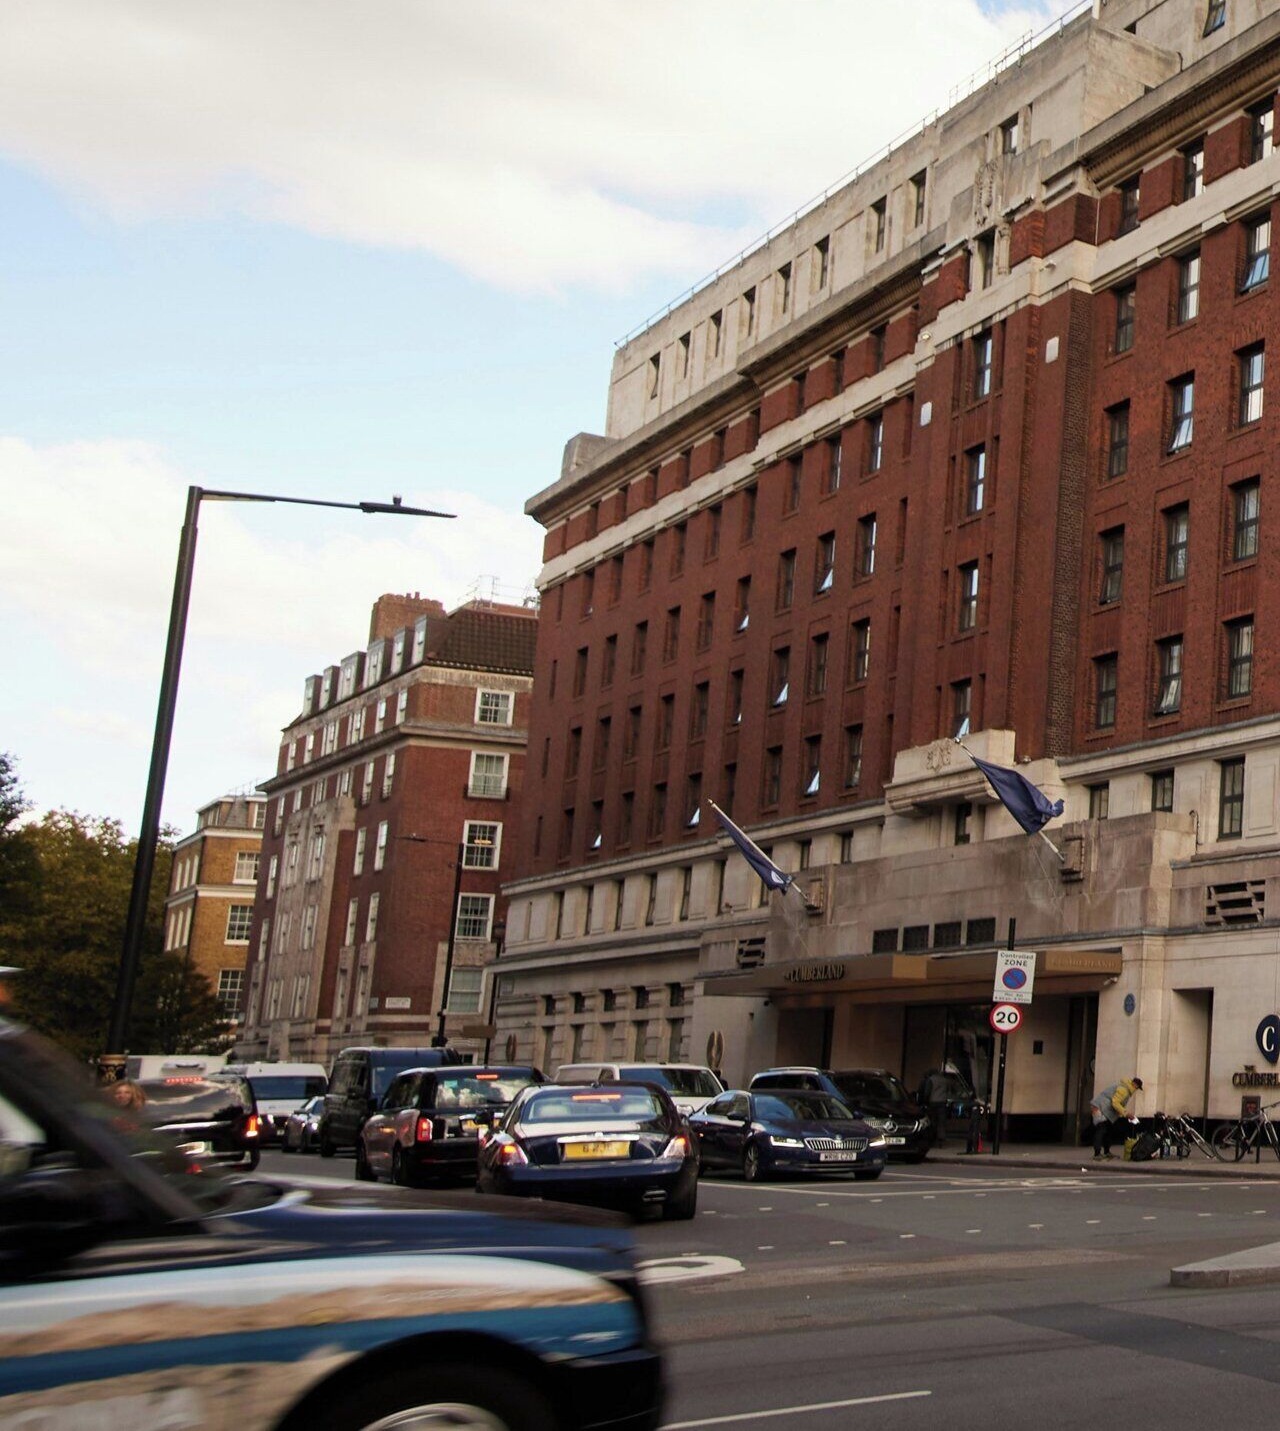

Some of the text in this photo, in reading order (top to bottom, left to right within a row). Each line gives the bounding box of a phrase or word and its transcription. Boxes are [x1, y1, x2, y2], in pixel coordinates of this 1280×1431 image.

[1000, 952, 1034, 960] Controlled
[1004, 959, 1028, 967] ZONE
[996, 1011, 1018, 1024] 20
[1262, 1025, 1275, 1052] C
